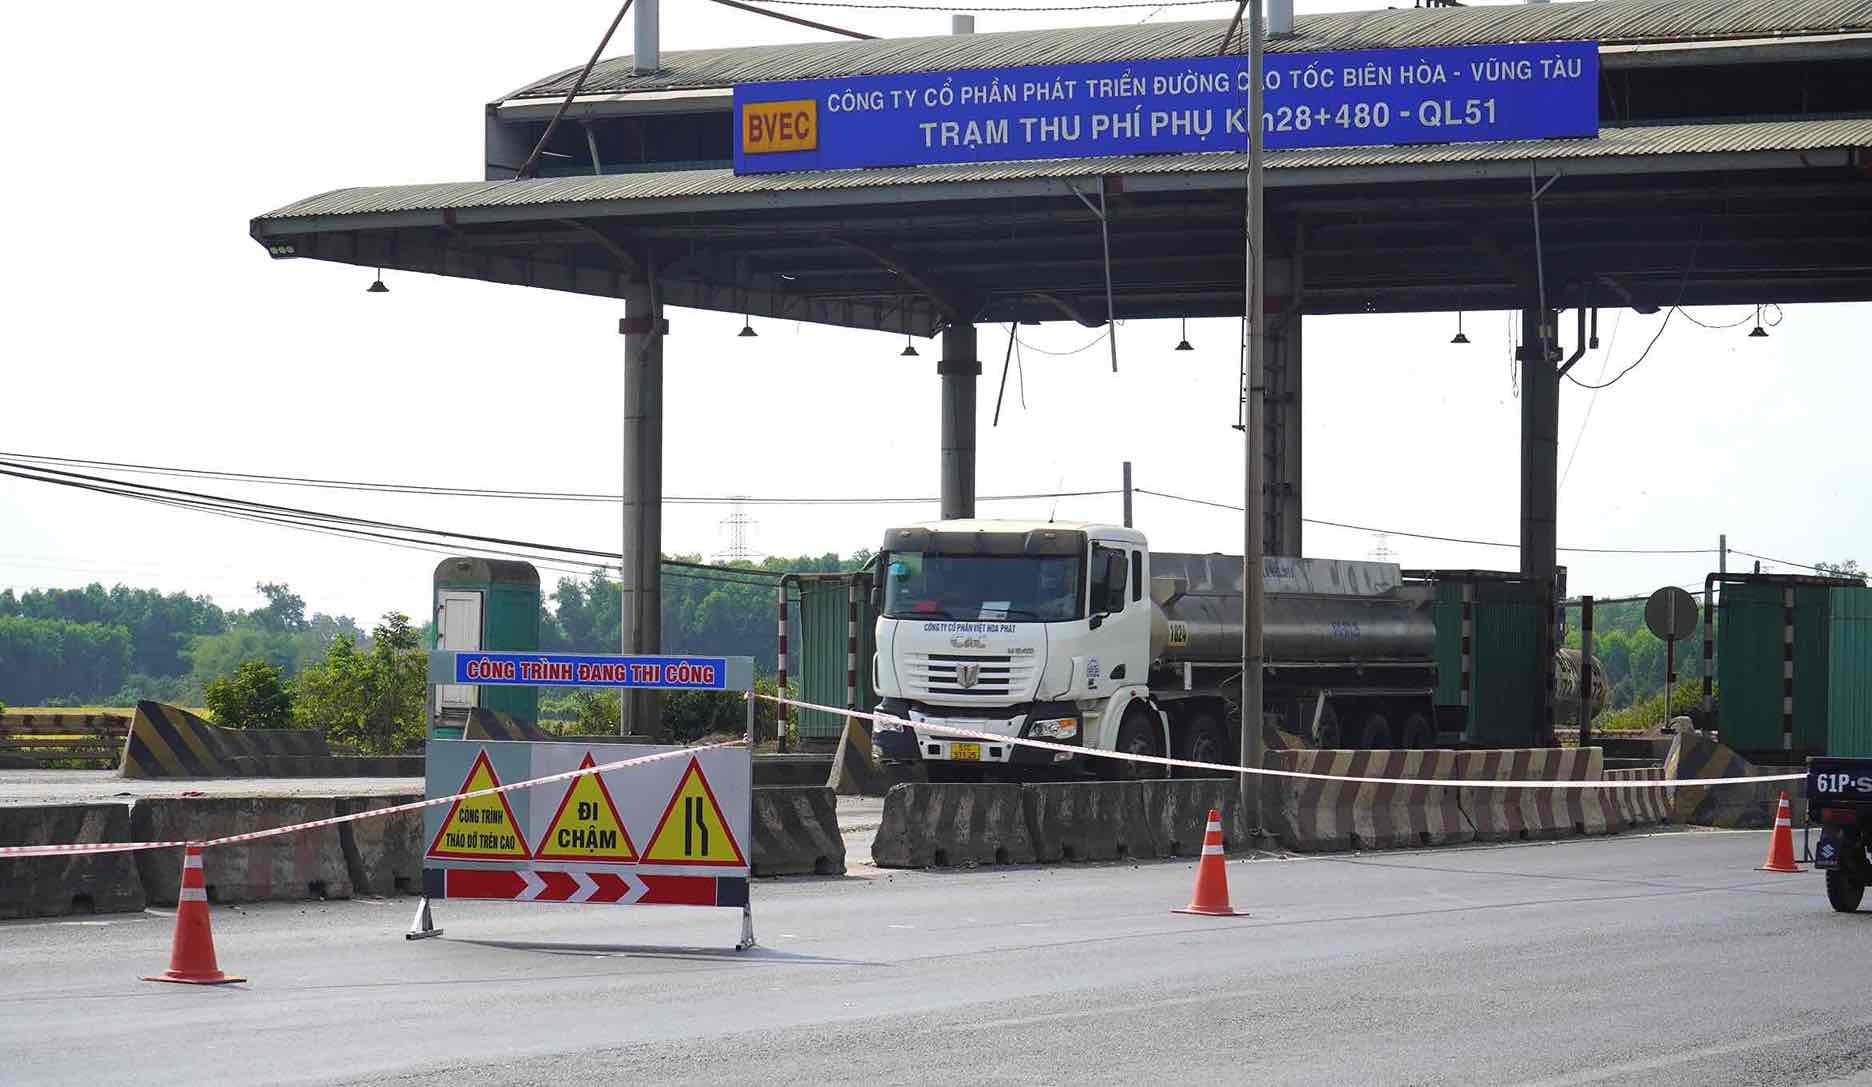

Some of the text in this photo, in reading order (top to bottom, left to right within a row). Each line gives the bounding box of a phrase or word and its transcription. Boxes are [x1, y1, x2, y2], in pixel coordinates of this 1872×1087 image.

[828, 86, 883, 112] CÔNG
[891, 88, 916, 109] TY
[924, 77, 953, 107] CỔ
[961, 77, 1016, 104] PHẦN
[1024, 74, 1077, 102] PHÁT
[1086, 69, 1147, 98] TRIỂN
[1154, 70, 1230, 96] ĐƯỜNG
[1238, 71, 1281, 90] CO
[1289, 61, 1335, 88] TỐC
[1343, 62, 1392, 87] BIÊN
[1401, 60, 1446, 85] HÒA
[1471, 57, 1532, 82] VŨNG
[1540, 54, 1582, 79] TÀU
[748, 111, 810, 143] BVEC
[919, 118, 1009, 149] TRẠM
[1019, 114, 1081, 143] THU
[1091, 104, 1142, 140] PHÍ
[1151, 109, 1212, 142] PHỤ
[1419, 98, 1497, 128] QL51
[467, 656, 715, 684] CÔNG TRÌNH ĐANG THI CÔNG
[459, 807, 503, 824] CÔNG TRÌNH
[578, 801, 598, 821] ĐI
[479, 832, 498, 849] TRÊN
[500, 835, 515, 850] CAO
[557, 826, 617, 853] CHẬM
